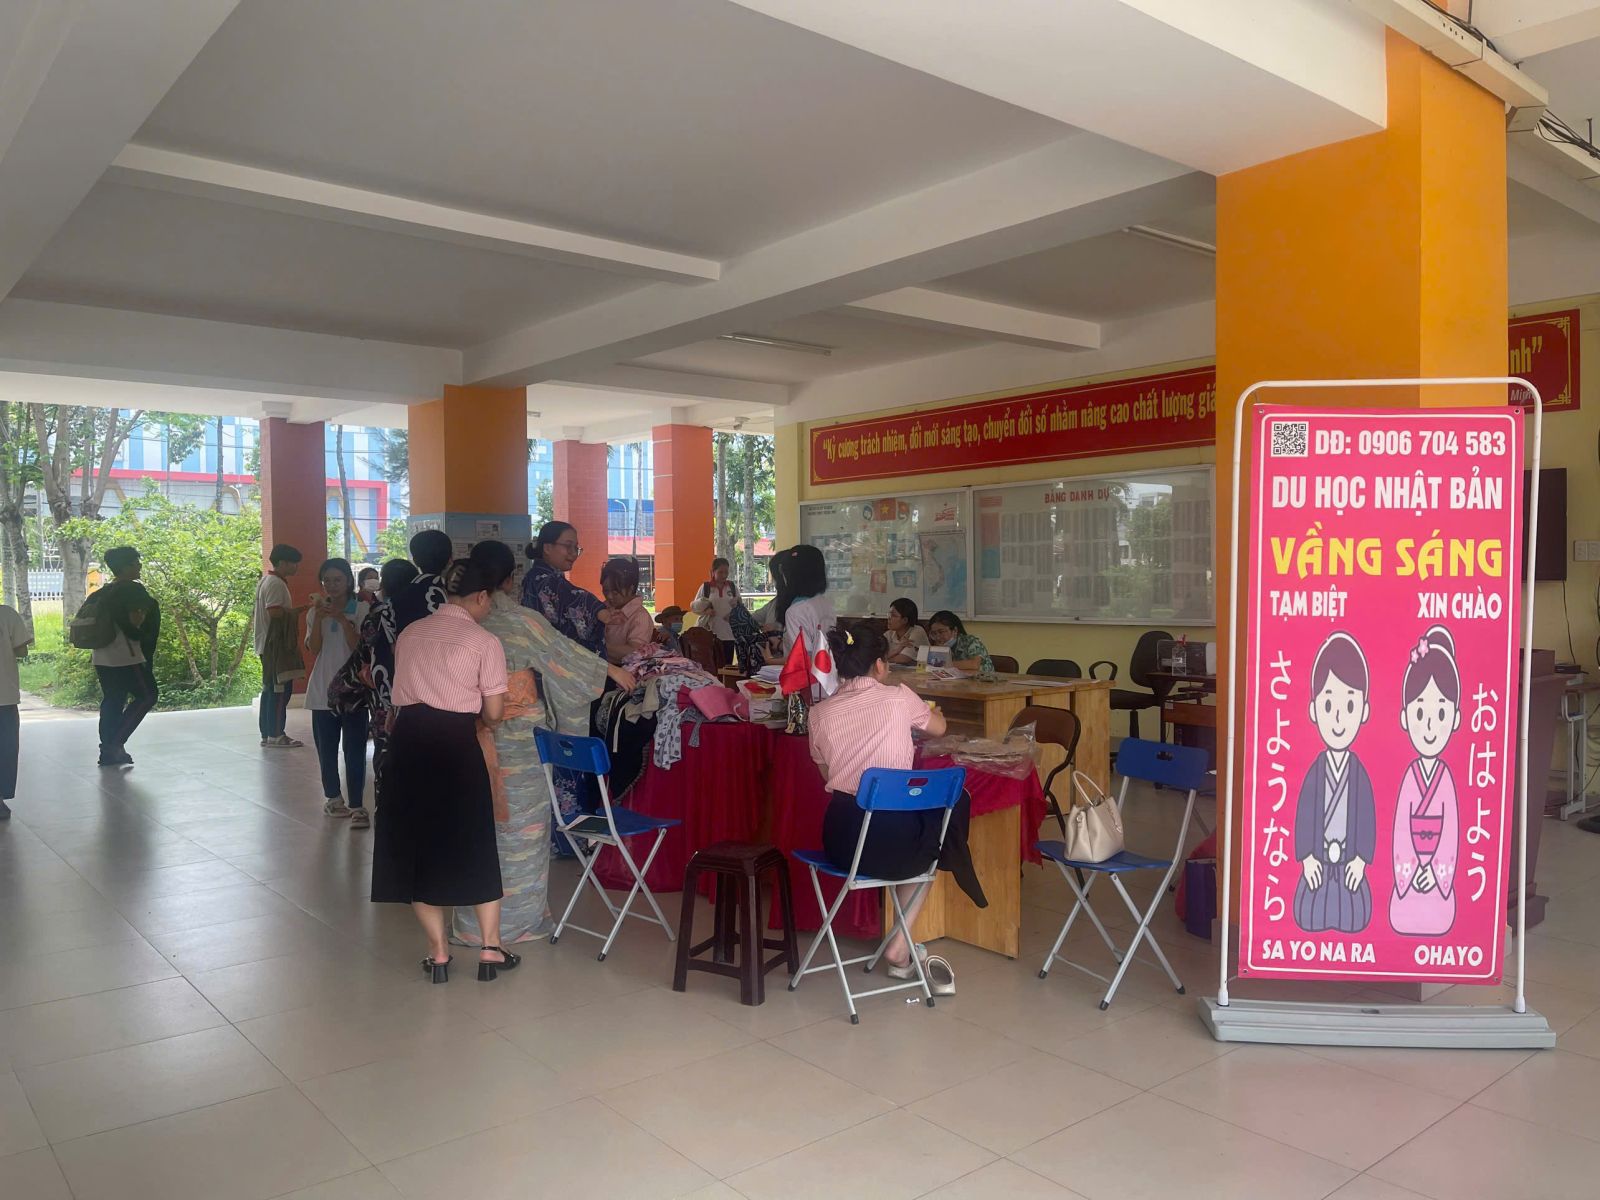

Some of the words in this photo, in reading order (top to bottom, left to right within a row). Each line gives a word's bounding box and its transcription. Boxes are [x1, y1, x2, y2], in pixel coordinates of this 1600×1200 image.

[861, 432, 880, 455] trách
[882, 429, 908, 457] nhiệm,
[924, 425, 939, 448] mới
[941, 420, 961, 448] sáng
[964, 419, 981, 447] tạo,
[983, 407, 1016, 443] chuyển
[1018, 404, 1033, 437] đổi
[1035, 404, 1048, 433] số
[1050, 400, 1078, 432] nhằm
[1081, 400, 1107, 430] nâng
[1110, 405, 1130, 425] cao
[1133, 388, 1159, 421] chất
[1162, 389, 1194, 423] lượng
[1315, 430, 1352, 455] DĐ:
[1359, 430, 1412, 455] 0906
[1419, 430, 1459, 456] 704
[1465, 431, 1506, 456] 583
[1070, 489, 1094, 502] DANH
[1272, 475, 1307, 509] DU
[1315, 475, 1366, 516] HỌC
[1375, 469, 1443, 517] NHẬT
[1450, 465, 1503, 510] BẢN
[1270, 521, 1382, 580] VẦNG
[1395, 529, 1503, 581] SÁNG
[1270, 590, 1308, 622] TẠM
[1312, 583, 1348, 623] BIỆT
[1417, 592, 1448, 619] XIN
[1451, 585, 1503, 620] CHÀO
[1262, 649, 1293, 922] さようなら
[1466, 682, 1498, 902] おはよう
[1262, 939, 1285, 960] SA
[1290, 940, 1317, 961] YO
[1320, 941, 1347, 963] NA
[1350, 942, 1376, 963] RA
[1414, 944, 1483, 967] OHAYO
